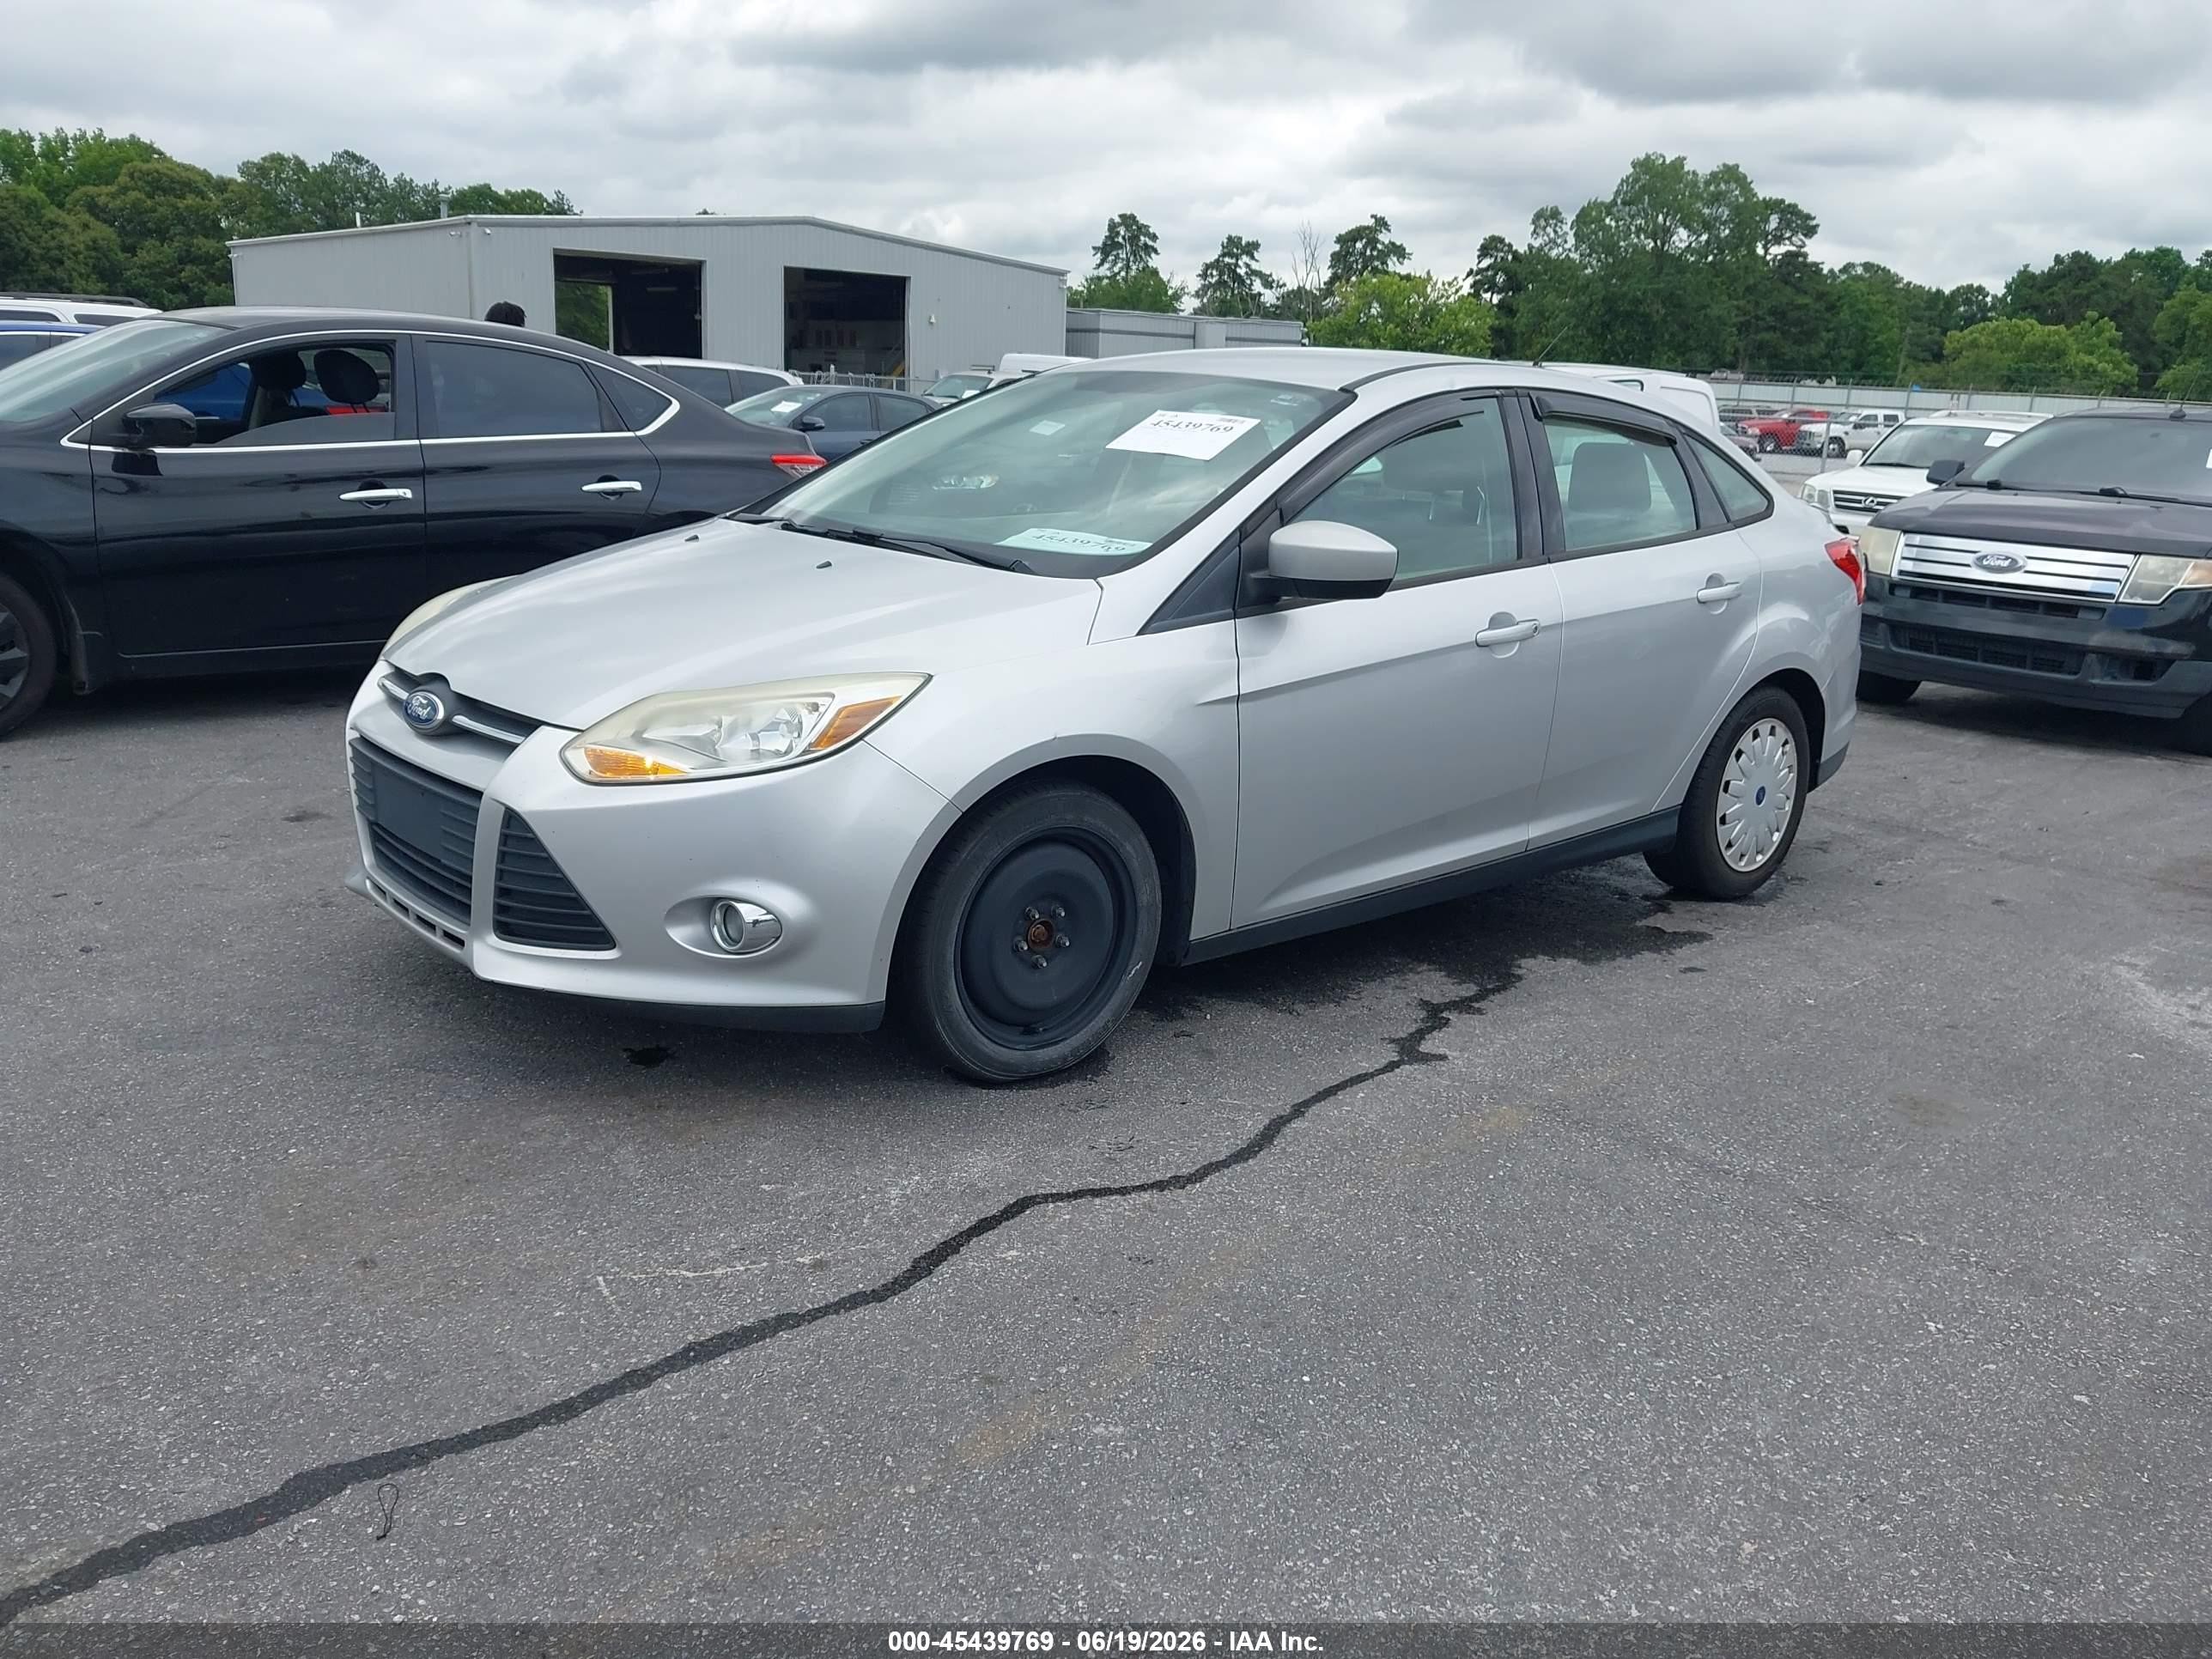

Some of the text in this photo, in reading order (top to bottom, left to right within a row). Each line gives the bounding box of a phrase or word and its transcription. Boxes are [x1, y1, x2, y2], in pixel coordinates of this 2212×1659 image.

[1151, 419, 1234, 433] 45439769
[1982, 555, 2012, 568] Ford
[406, 696, 432, 720] Ford
